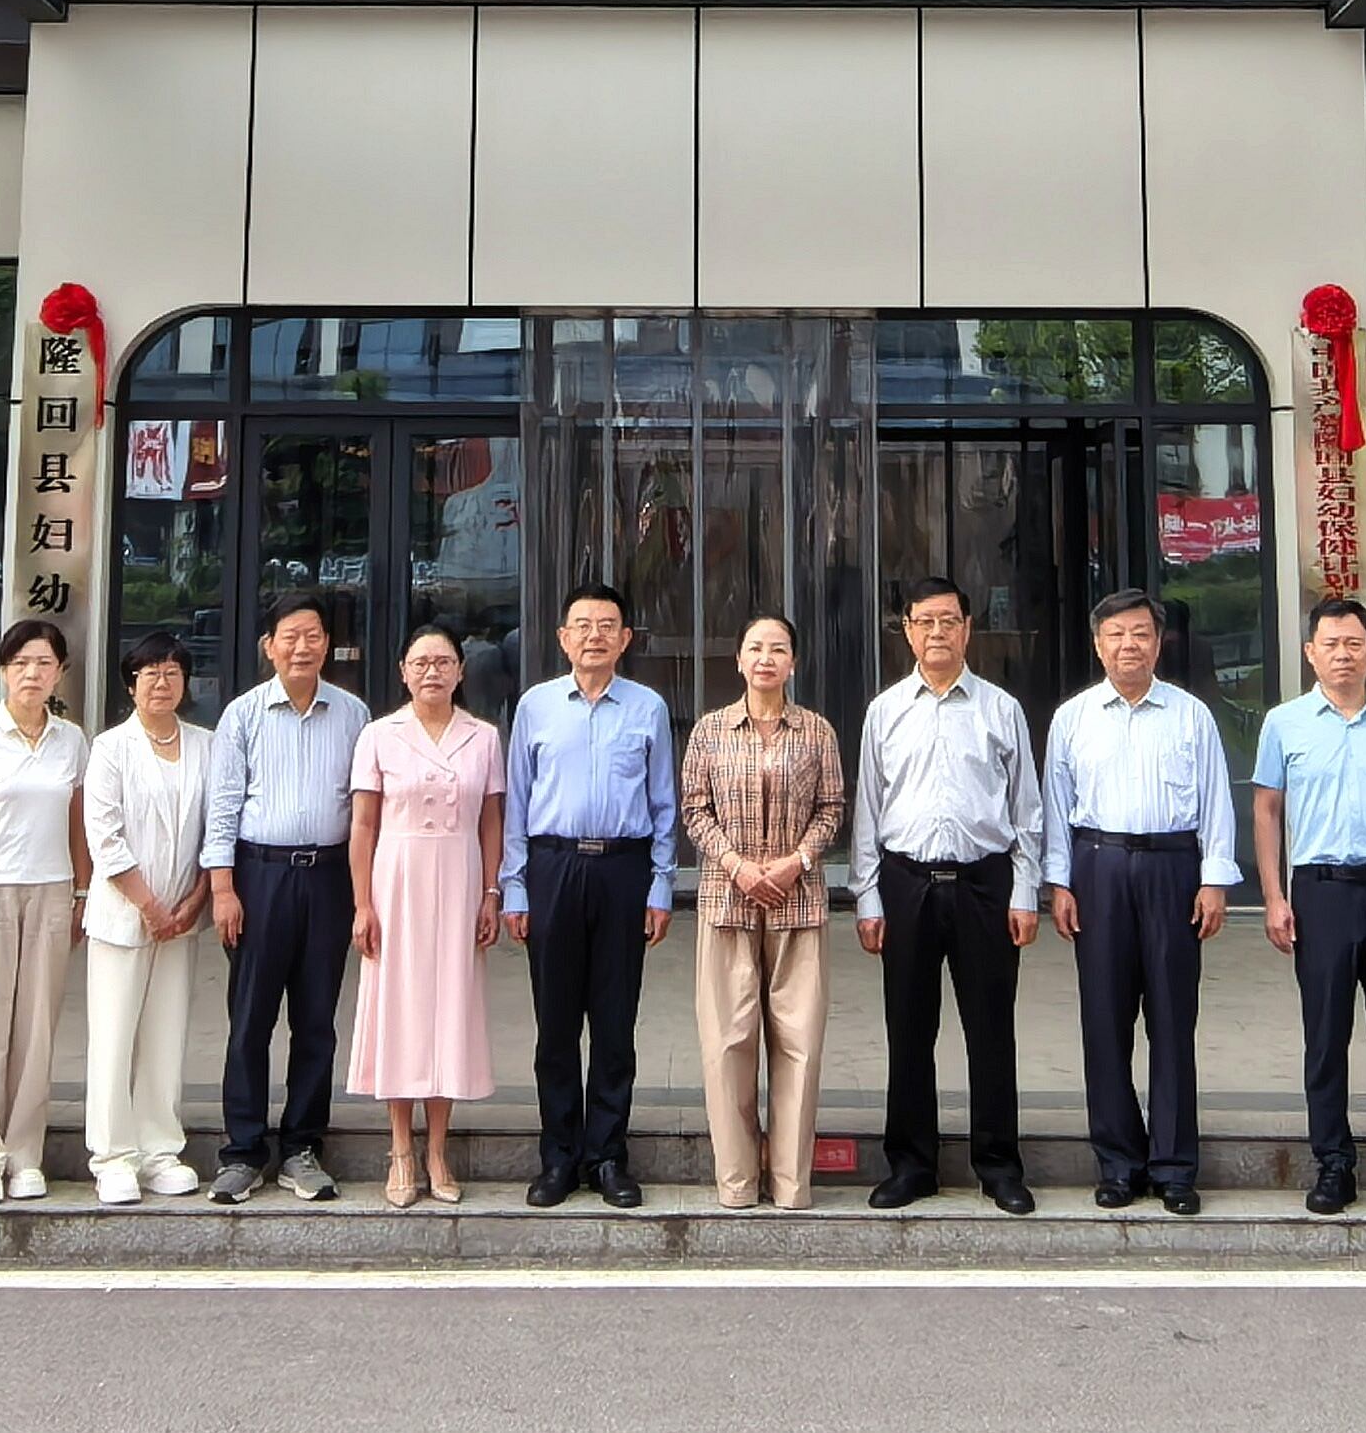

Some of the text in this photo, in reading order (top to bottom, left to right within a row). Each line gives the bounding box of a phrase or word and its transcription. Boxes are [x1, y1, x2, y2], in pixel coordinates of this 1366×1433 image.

[28, 336, 82, 717] 隆回县妇幼
